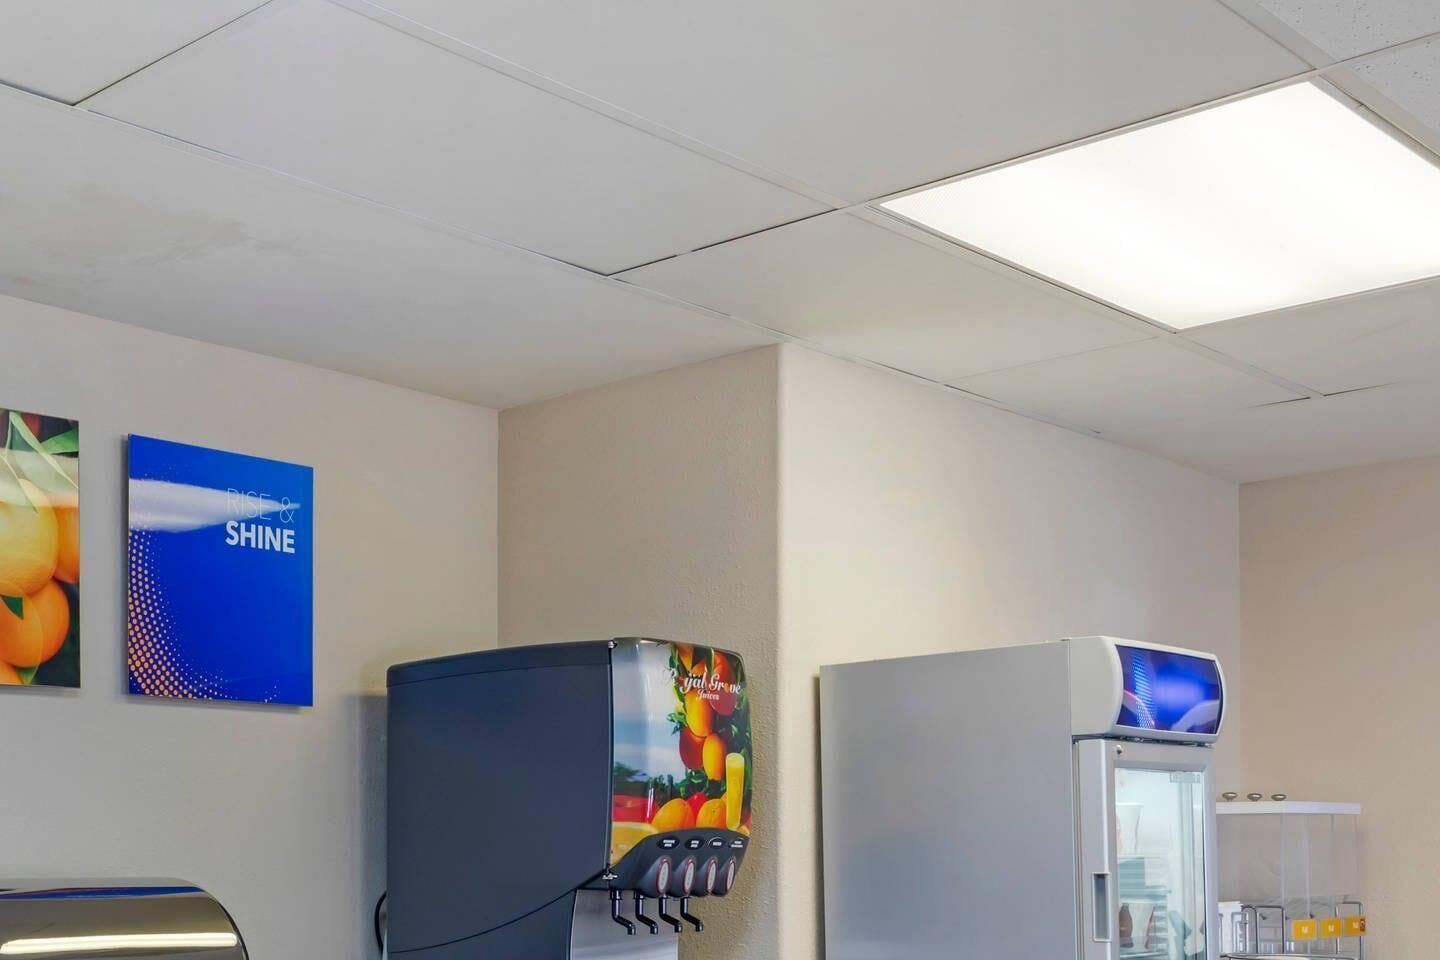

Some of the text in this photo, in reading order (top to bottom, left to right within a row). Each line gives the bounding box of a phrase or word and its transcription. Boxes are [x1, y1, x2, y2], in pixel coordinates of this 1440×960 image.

[227, 488, 295, 524] RISE &
[225, 520, 296, 554] SHINE
[708, 673, 741, 694] Grove
